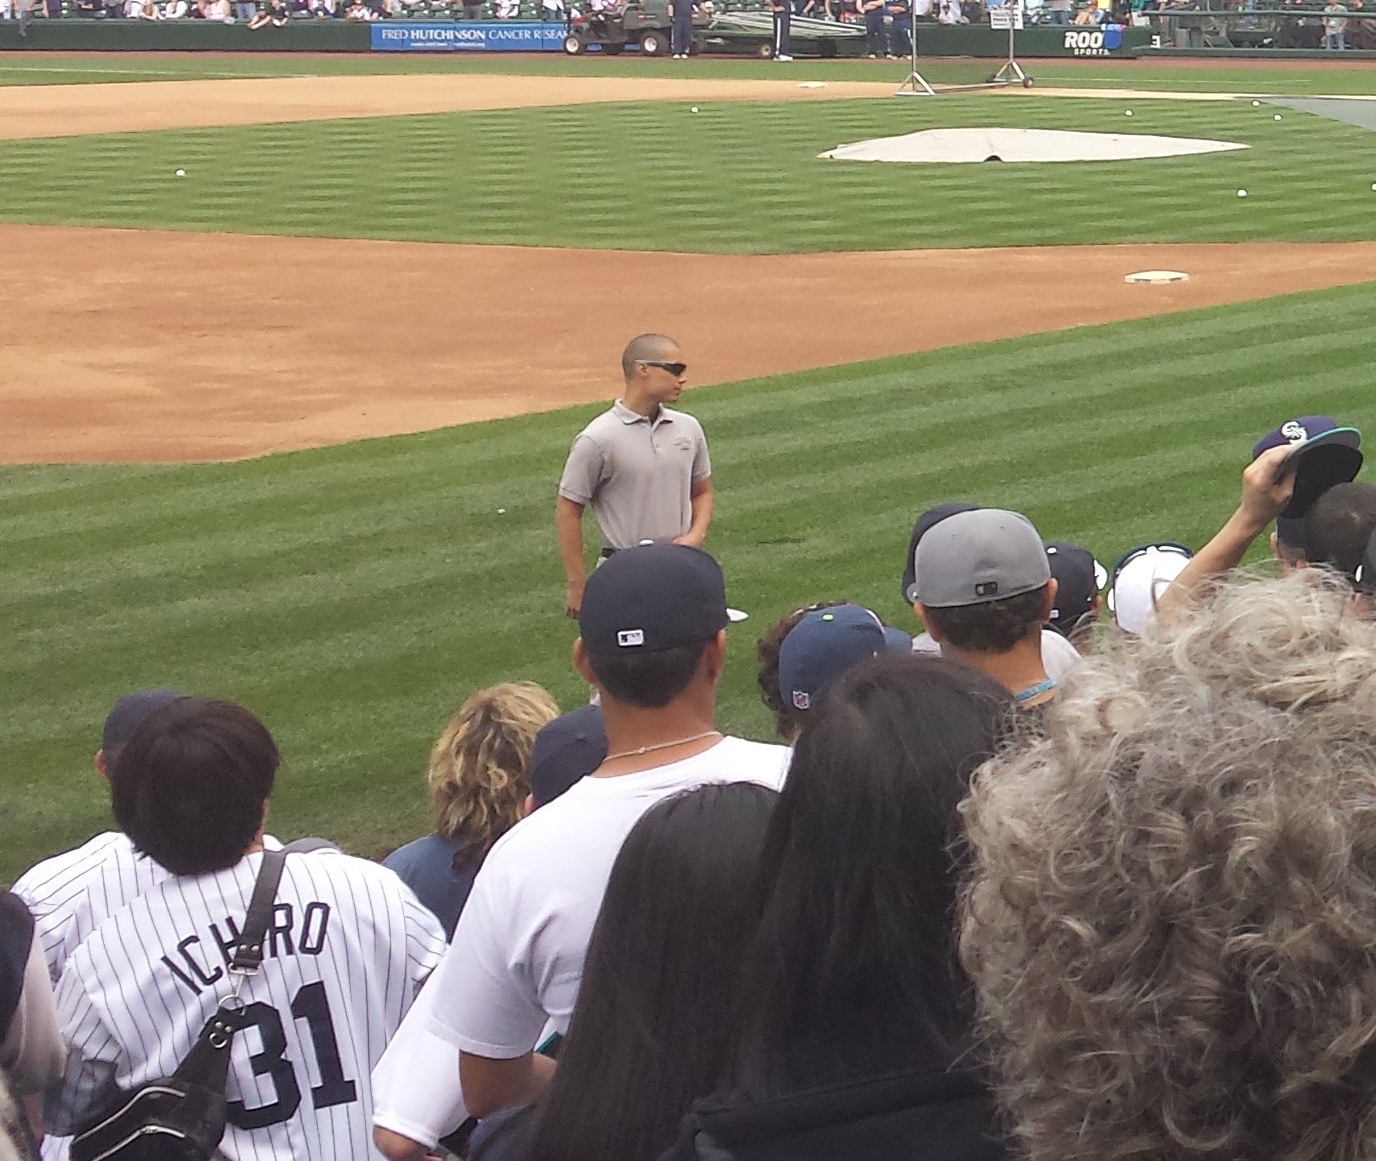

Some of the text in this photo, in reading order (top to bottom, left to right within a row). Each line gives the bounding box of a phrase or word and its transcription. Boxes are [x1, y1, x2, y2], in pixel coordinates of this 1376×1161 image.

[382, 29, 409, 40] FRED
[410, 29, 486, 40] HUTCHINSON
[488, 29, 531, 40] CANCER
[1064, 31, 1105, 49] ROO
[160, 901, 331, 997] ICHRO
[222, 979, 358, 1131] 31
